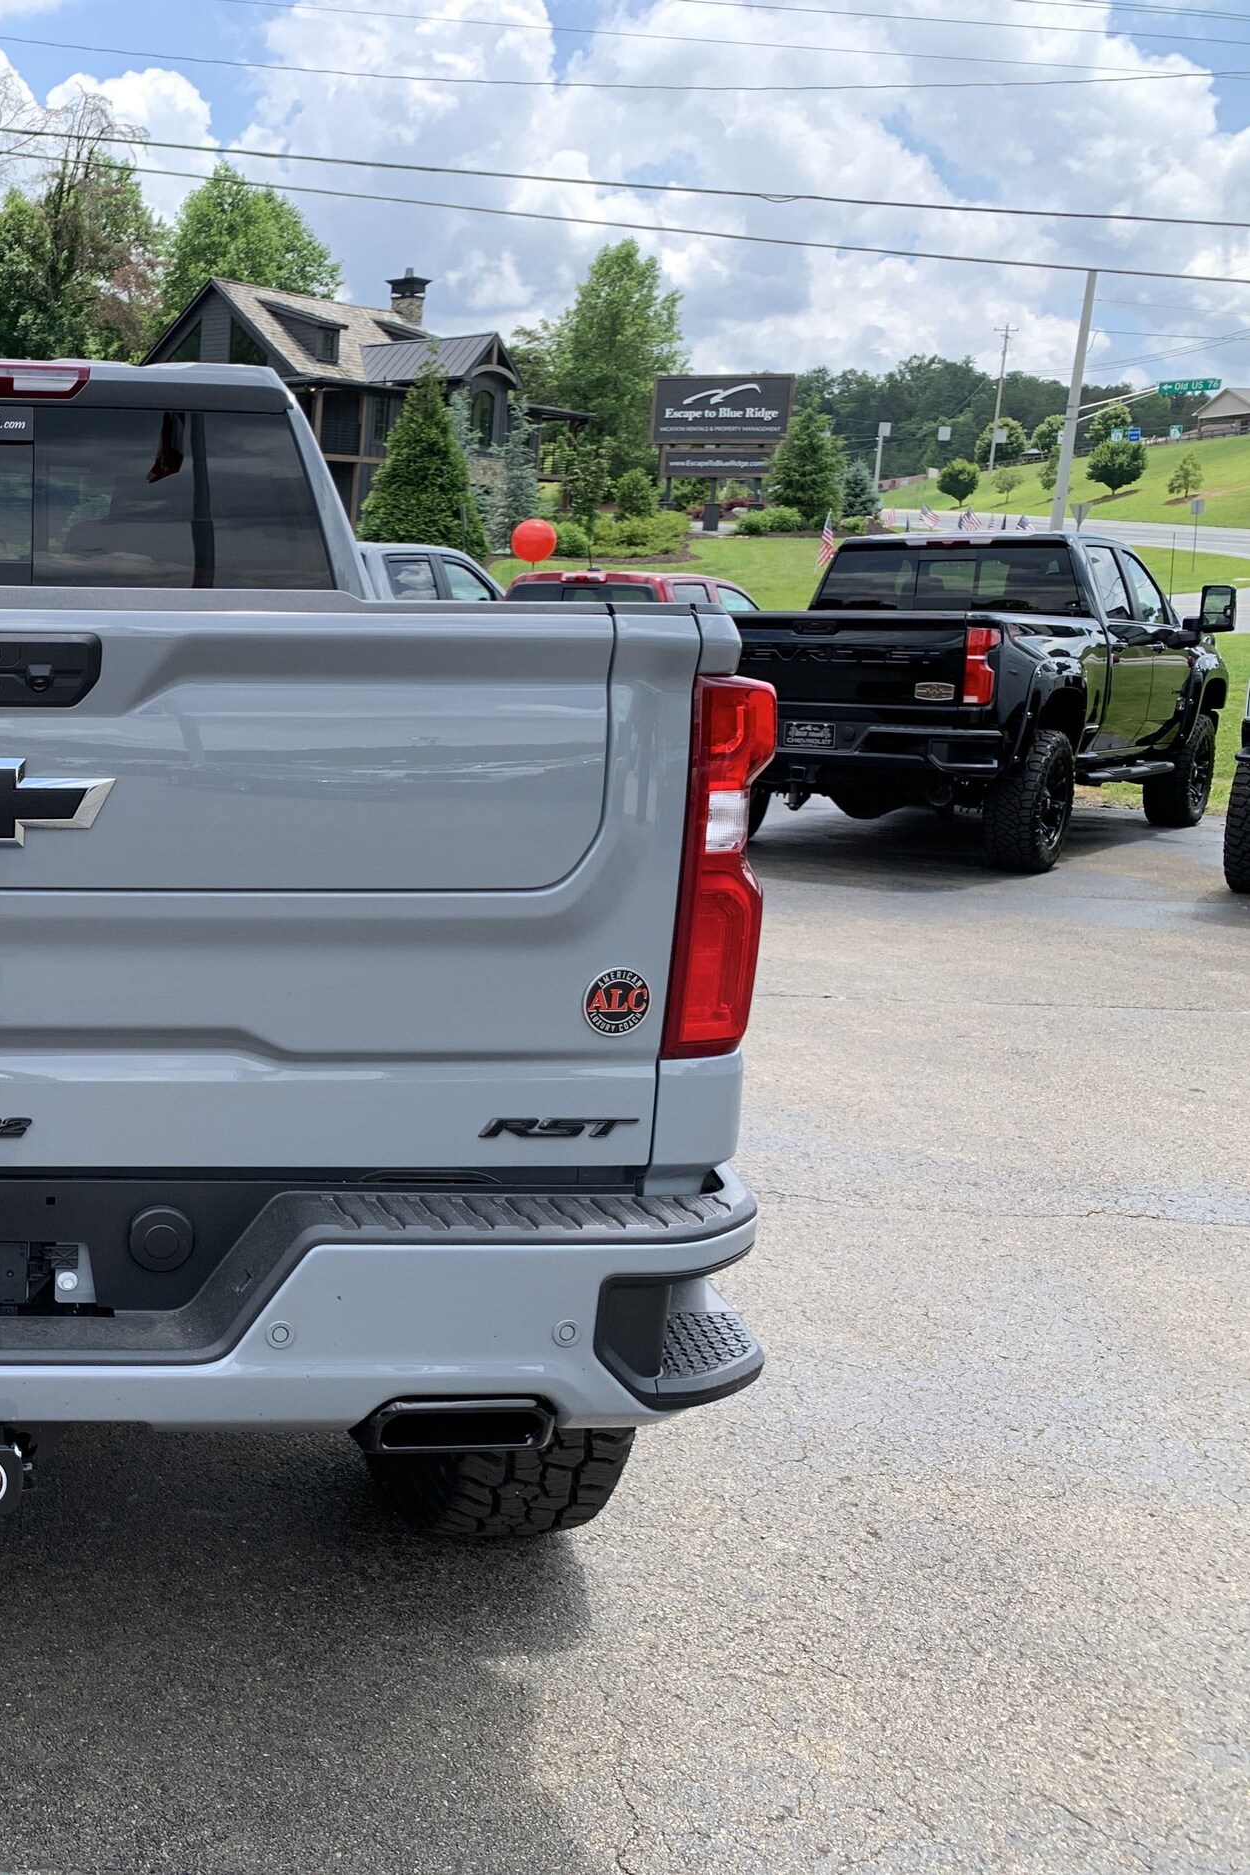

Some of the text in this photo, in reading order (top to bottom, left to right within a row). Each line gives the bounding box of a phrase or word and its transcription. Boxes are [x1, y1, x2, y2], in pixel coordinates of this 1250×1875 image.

[1174, 380, 1219, 391] Old US 76
[664, 407, 779, 421] Escape to Blue Ridge
[741, 644, 941, 664] EVROLET
[786, 737, 832, 745] CHEVROLET
[597, 971, 643, 987] AMERICAN
[588, 988, 647, 1012] ALC
[590, 1013, 642, 1032] LUXURY COACH
[478, 1117, 640, 1138] RST
